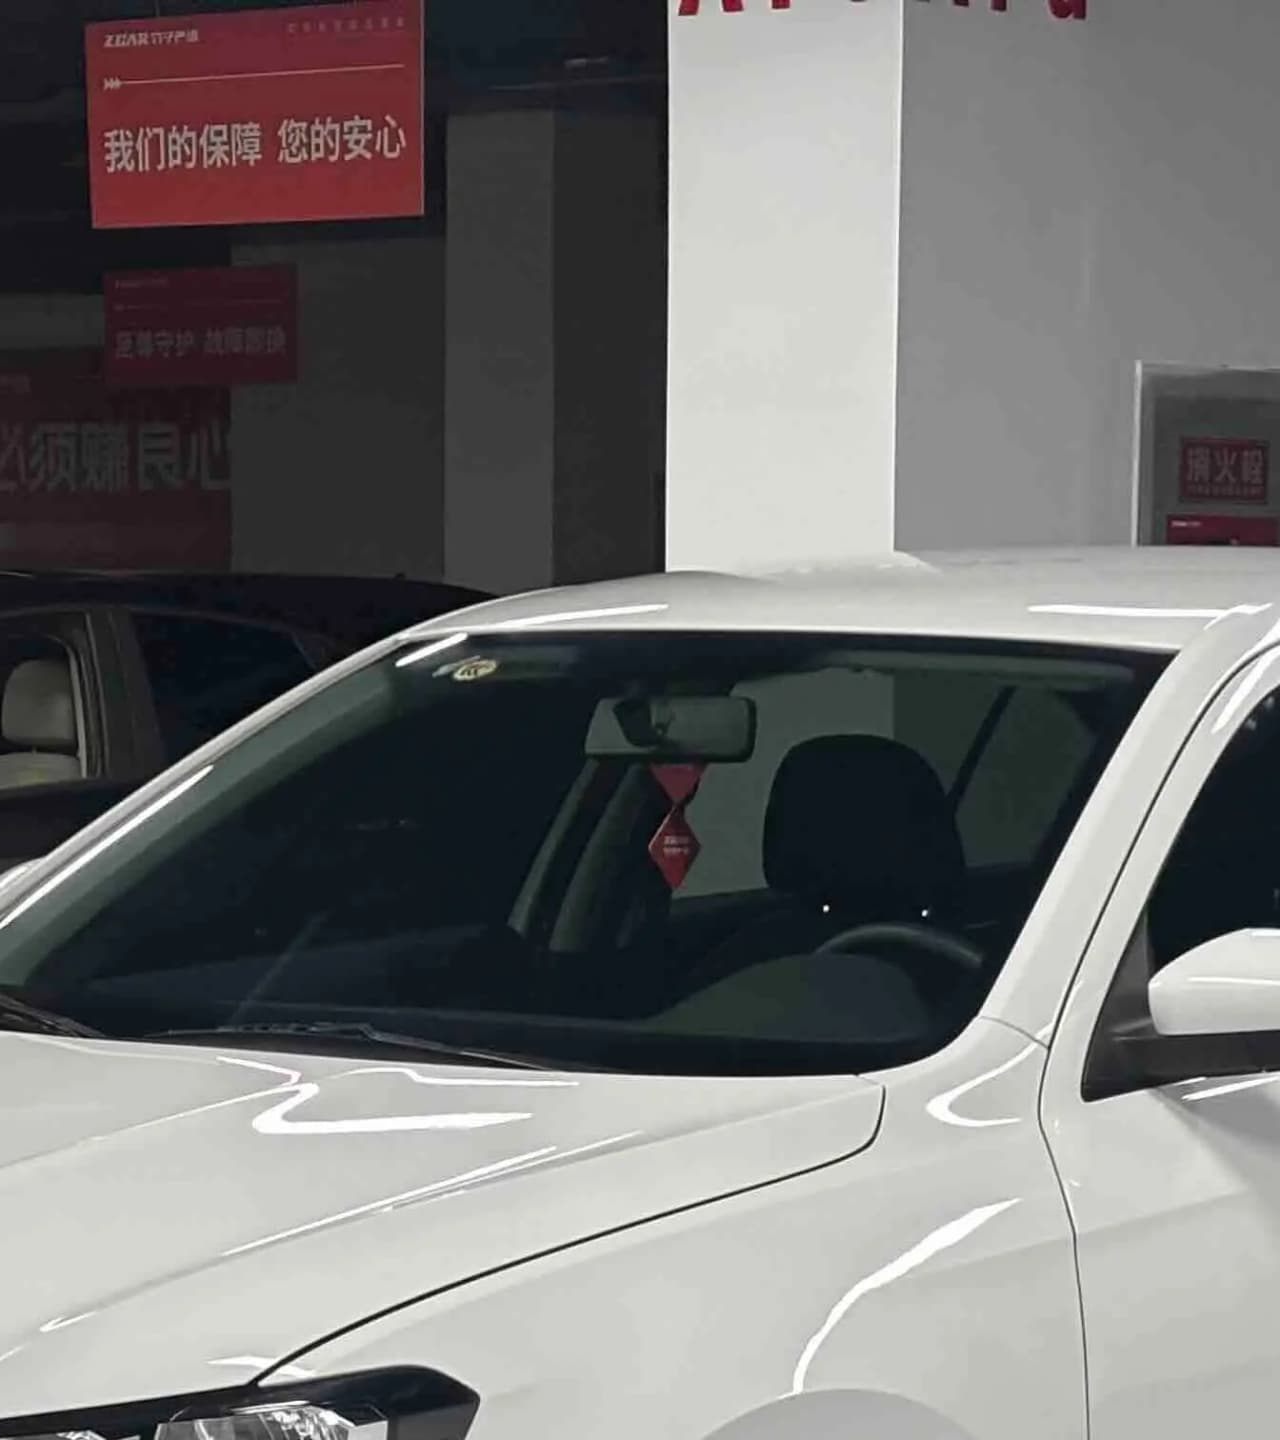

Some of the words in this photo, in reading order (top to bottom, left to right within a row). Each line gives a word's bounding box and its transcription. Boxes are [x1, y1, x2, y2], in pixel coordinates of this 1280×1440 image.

[104, 122, 262, 174] 我们的保障
[277, 114, 407, 164] 您的安心
